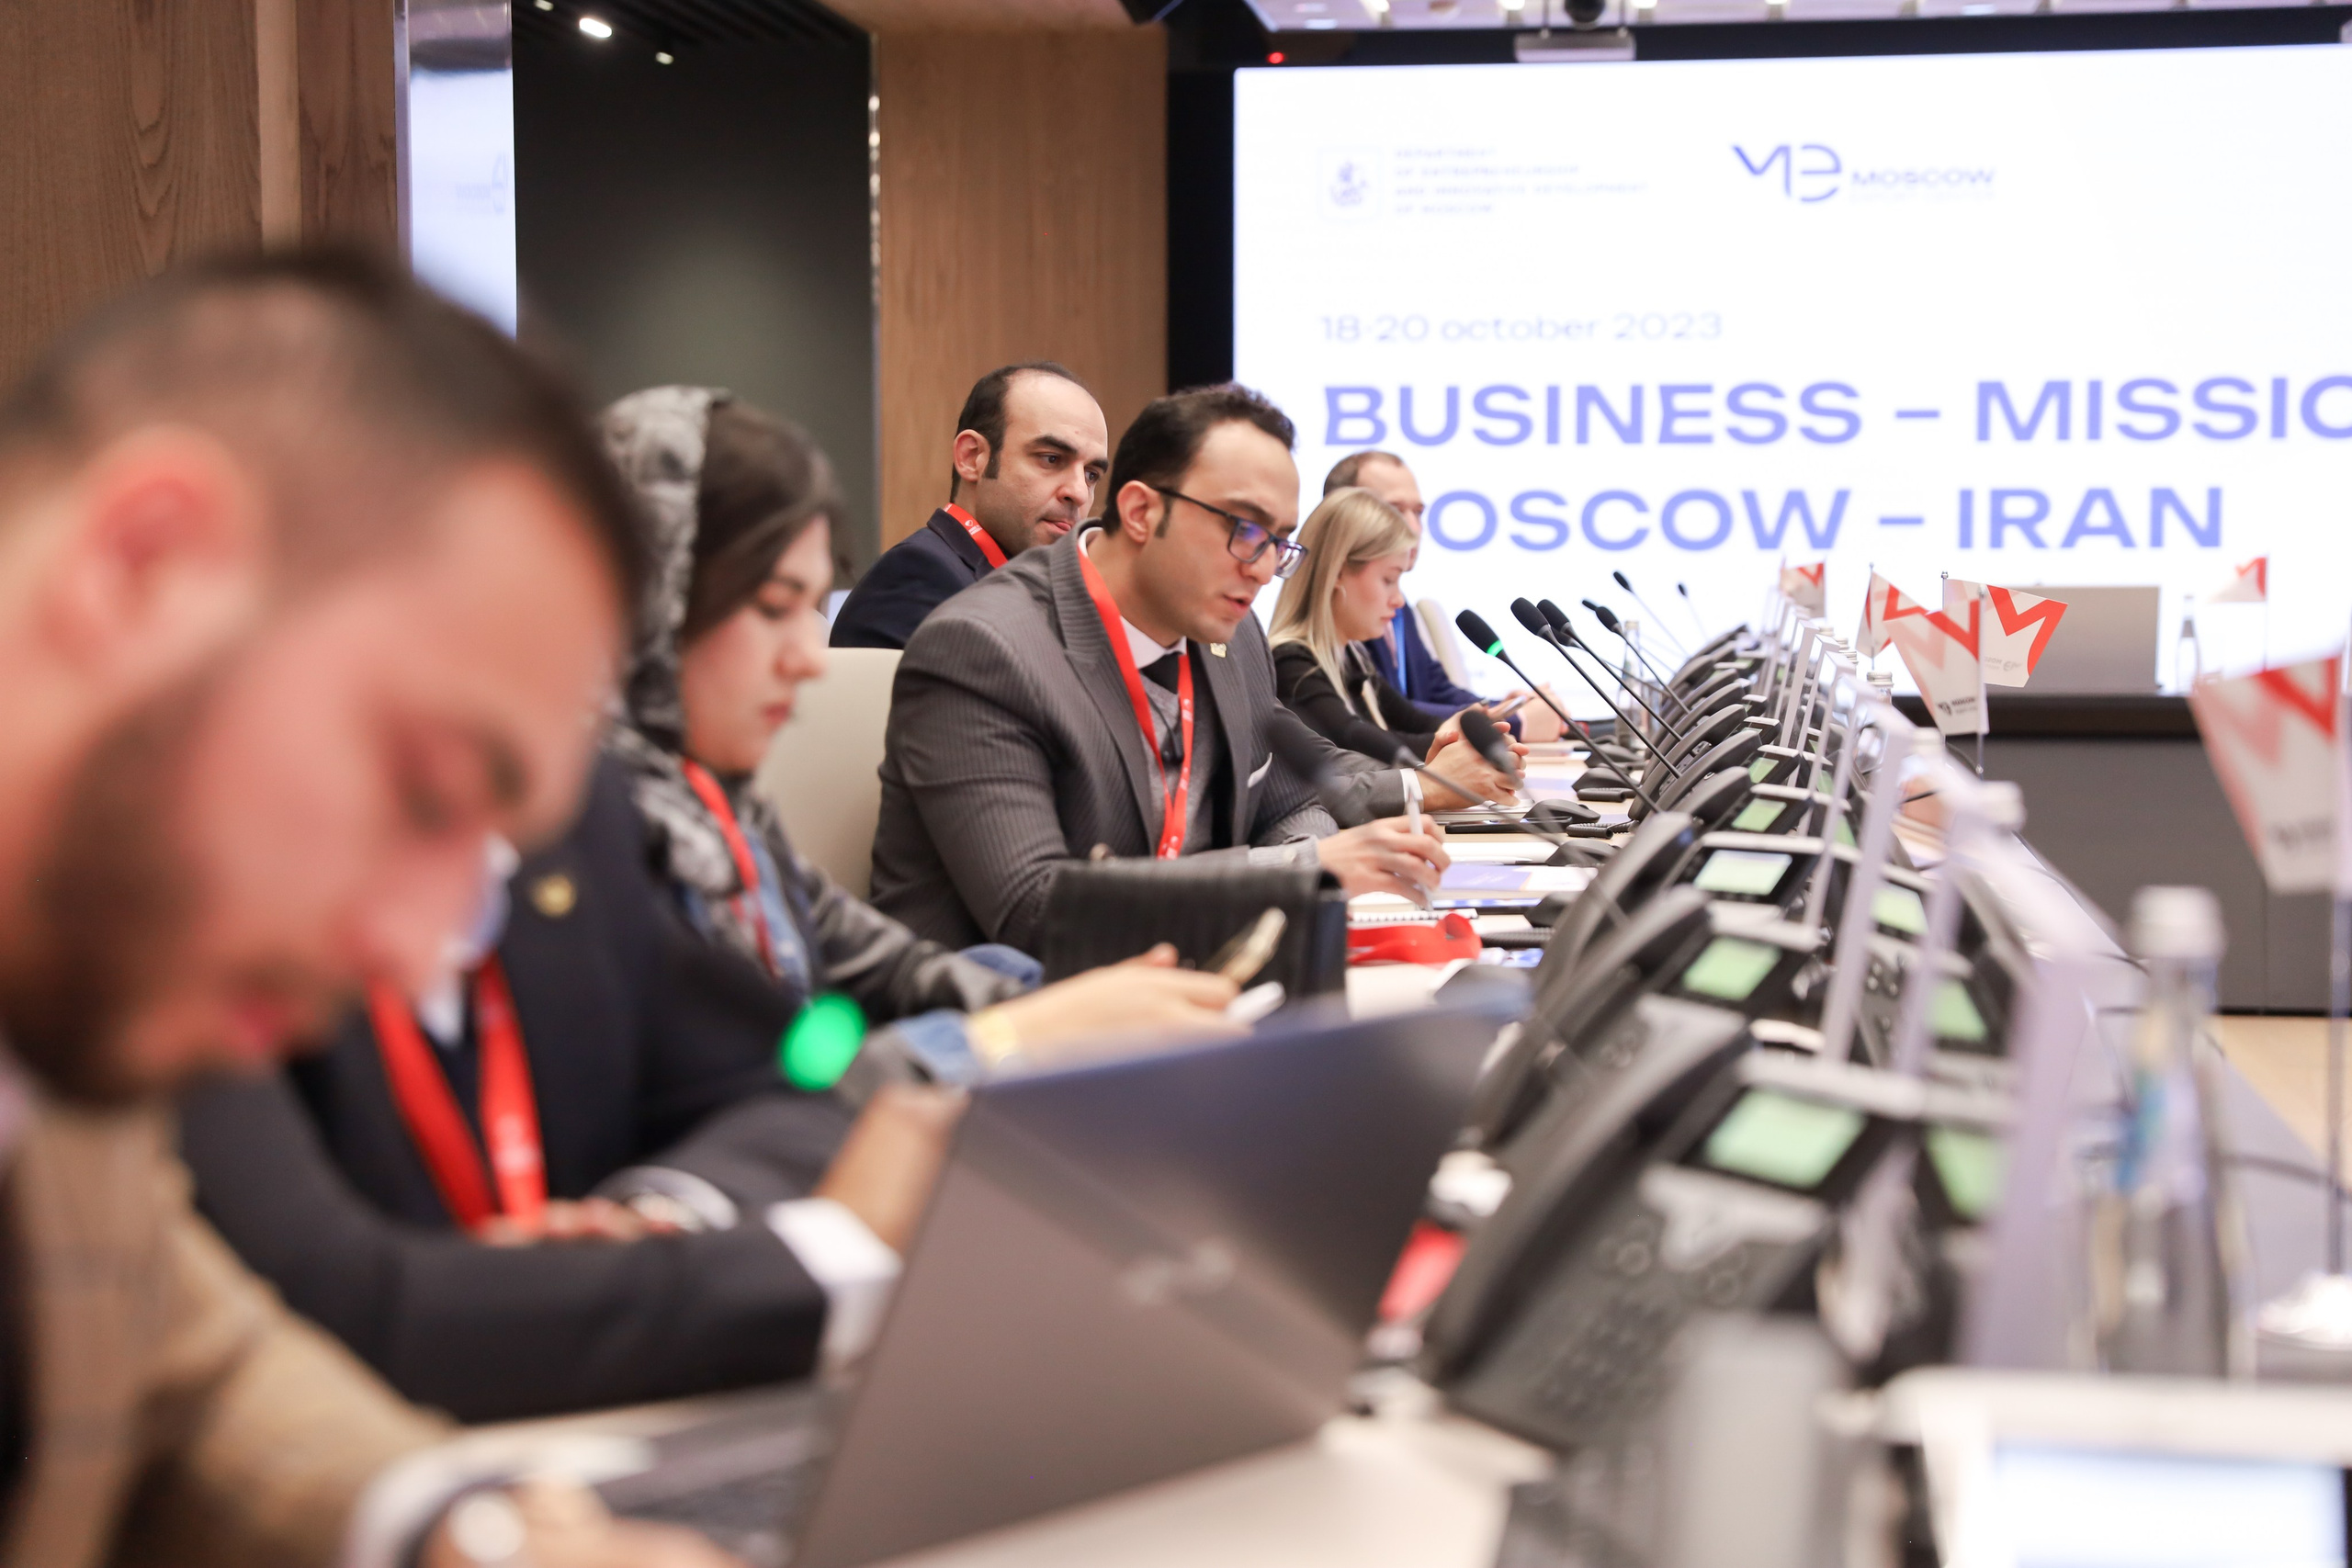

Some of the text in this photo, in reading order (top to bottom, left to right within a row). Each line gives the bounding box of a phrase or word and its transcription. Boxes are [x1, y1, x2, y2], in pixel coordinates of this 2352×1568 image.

[1851, 169, 1995, 186] MOSCOW
[1441, 315, 1596, 341] october
[1615, 313, 1723, 341] 2023
[1324, 381, 1862, 447] BUSINESS
[1428, 489, 1851, 552] OSCOW
[1957, 486, 2223, 549] IRAN
